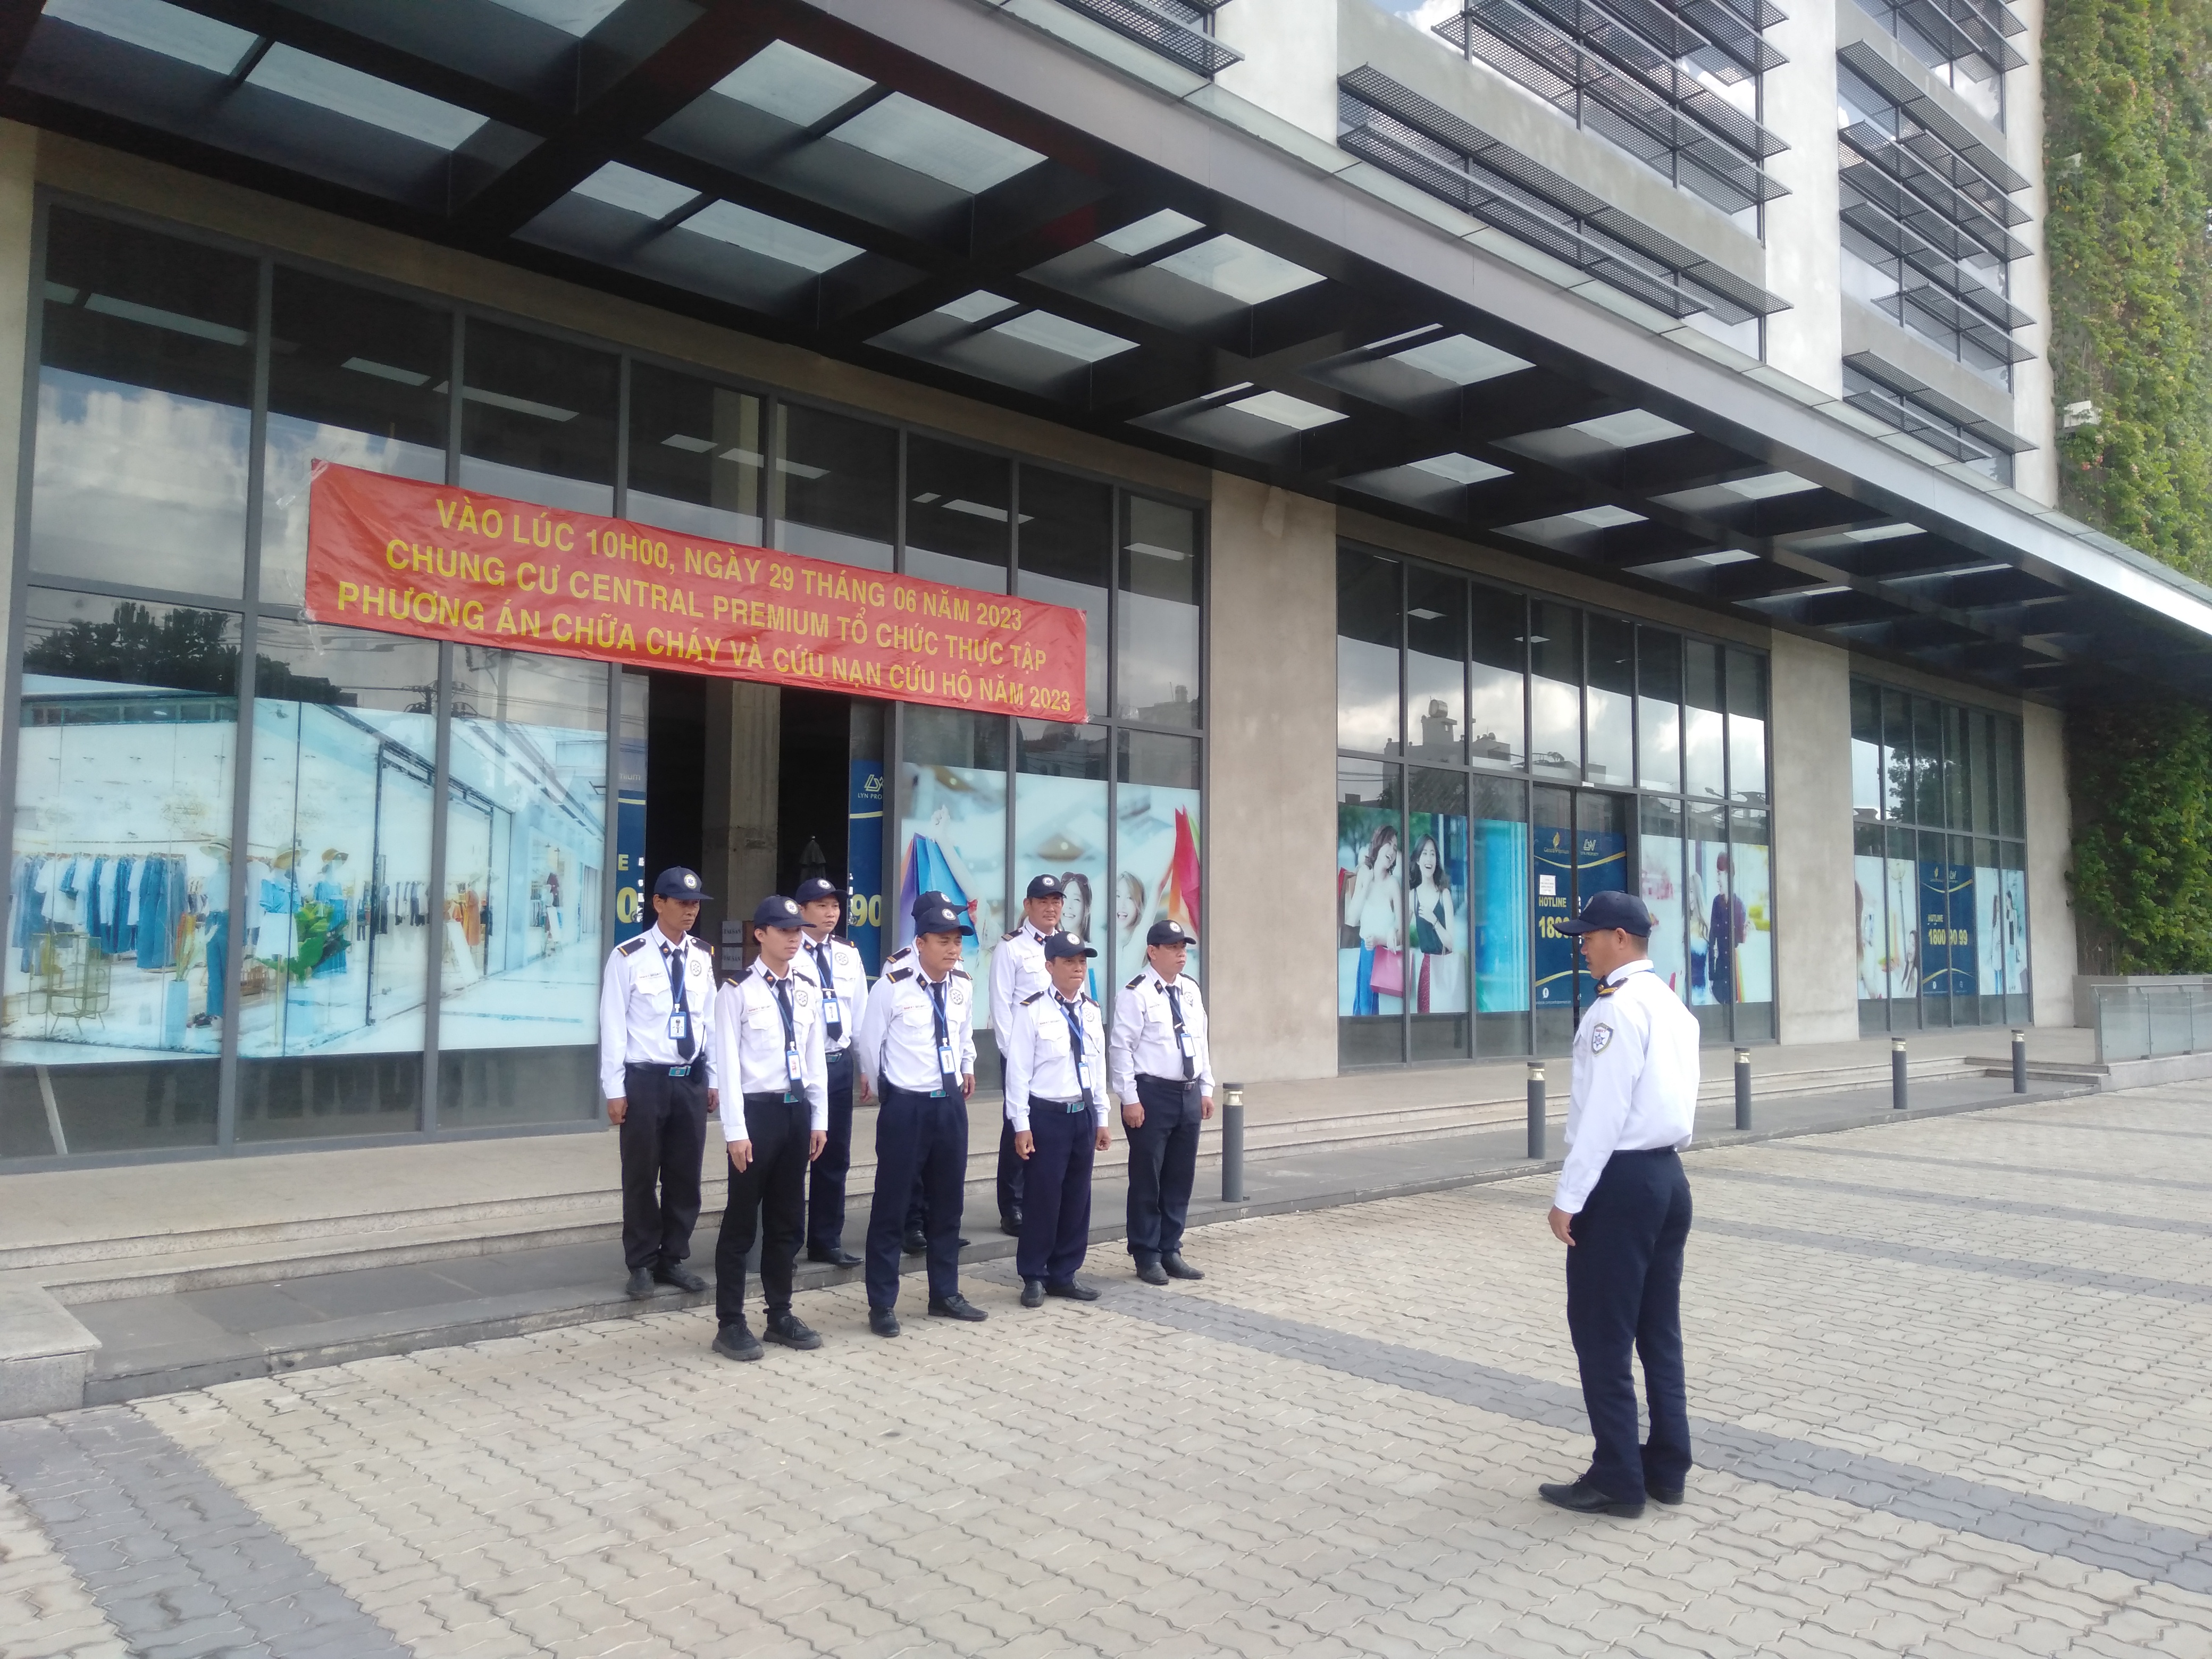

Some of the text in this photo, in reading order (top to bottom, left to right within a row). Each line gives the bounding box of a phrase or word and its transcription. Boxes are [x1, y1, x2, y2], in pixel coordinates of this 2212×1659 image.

[386, 539, 1046, 672] CHUNG CƯ CENTRAL PREMIUM TỔ CHỨC THỰC TẬP
[436, 496, 1022, 631] VÀO LÚC 10H00, NGÀY 29 THÁNG 06 NĂM 2023
[338, 581, 1071, 713] PHƯƠNG ÁN CHỮA CHÁY VÀ CỨU NẠN CỨU HỘ NĂM 2023
[1539, 896, 1567, 908] HOTLINE
